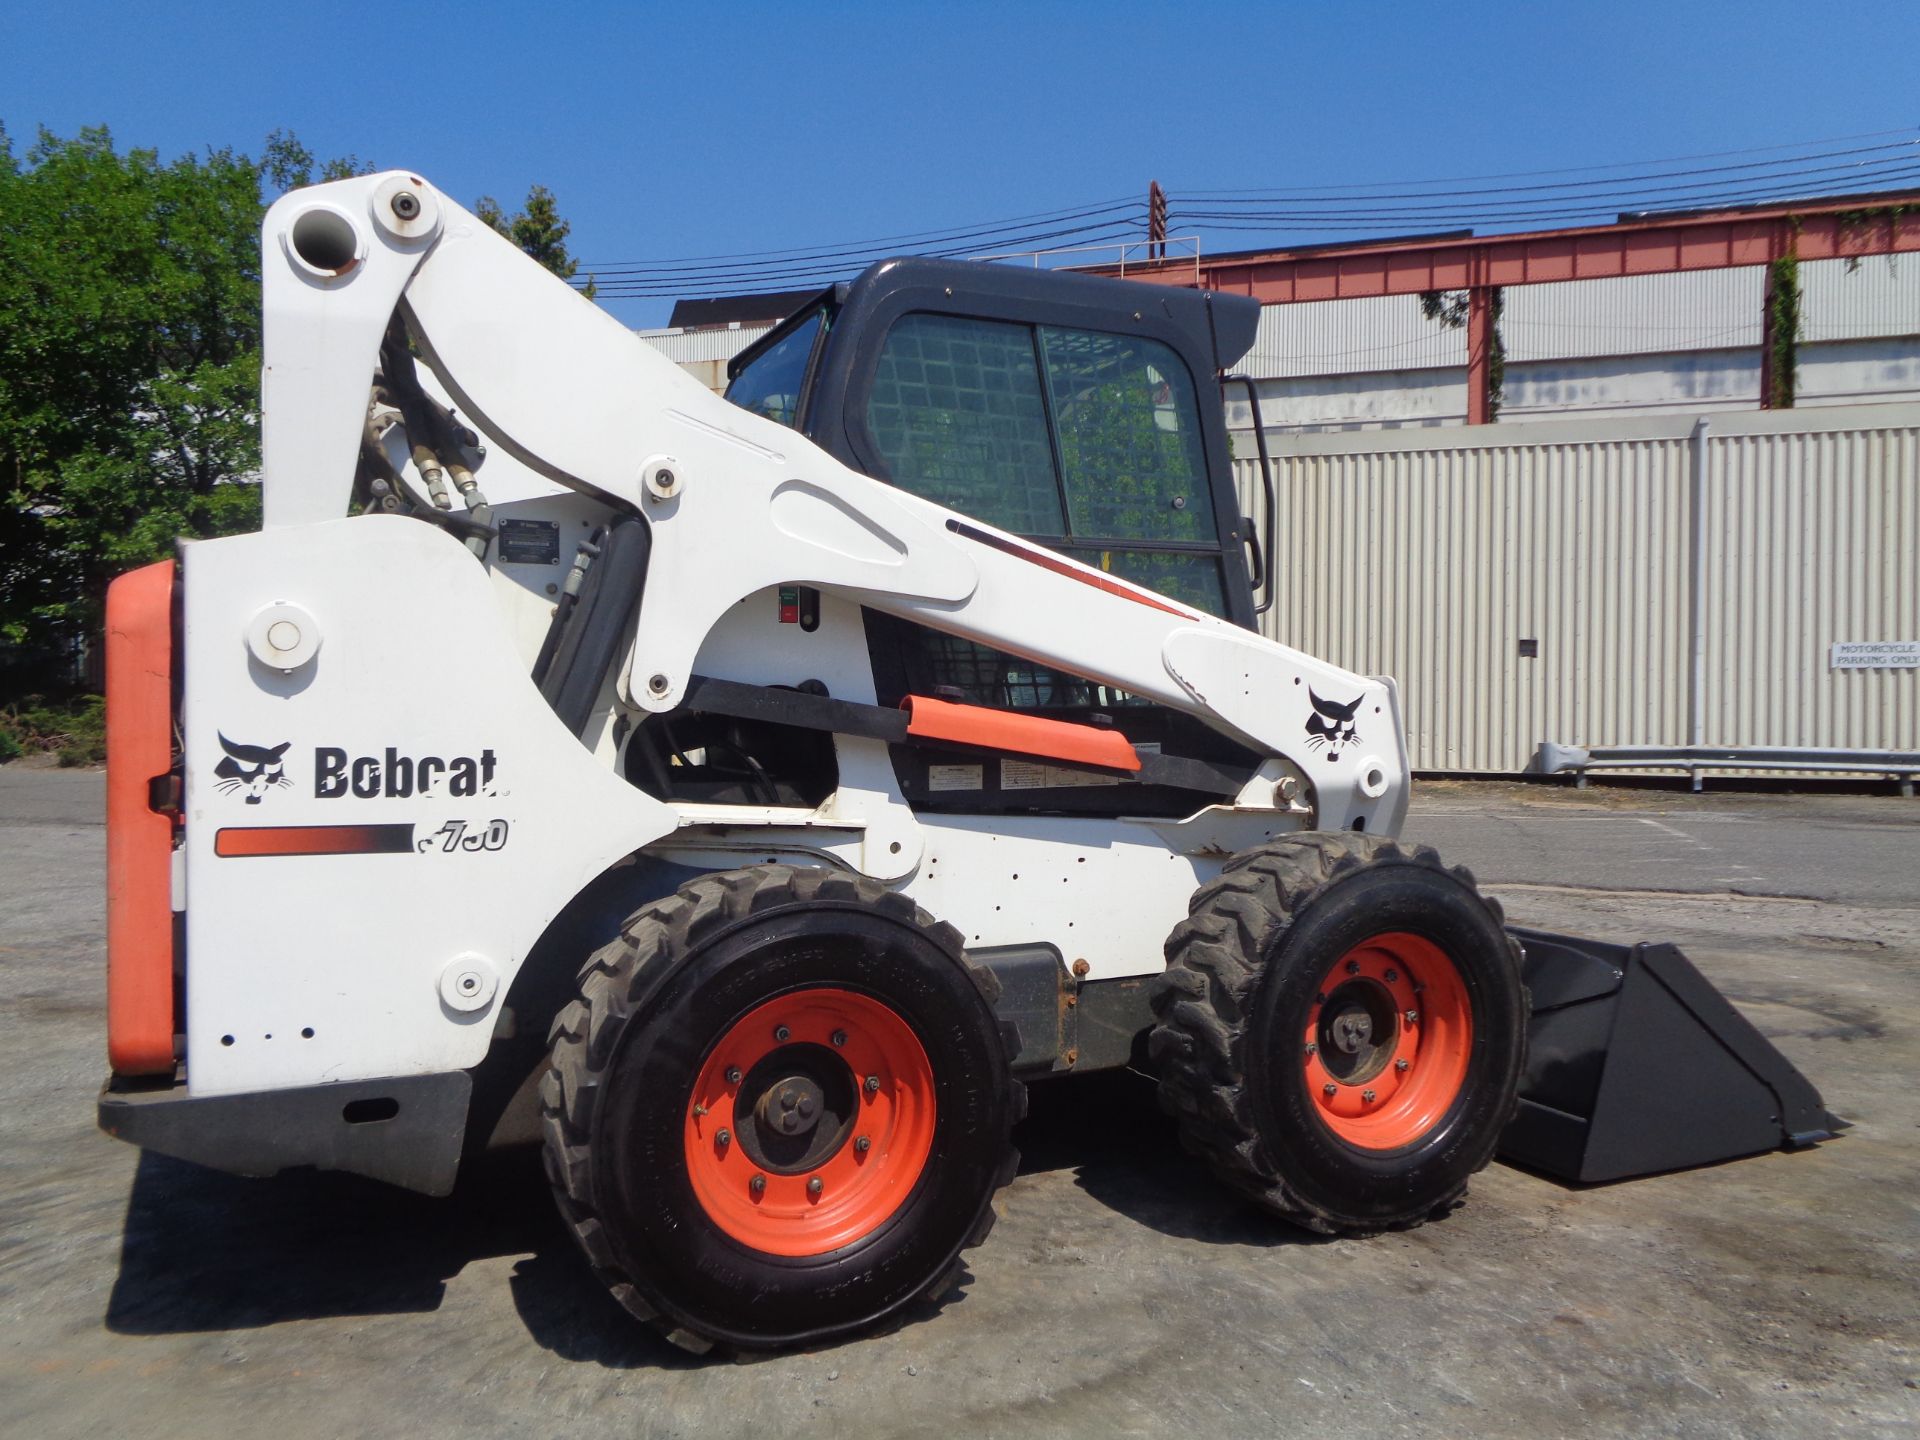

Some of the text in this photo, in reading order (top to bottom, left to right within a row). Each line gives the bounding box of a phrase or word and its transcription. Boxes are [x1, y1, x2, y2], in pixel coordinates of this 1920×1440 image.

[1841, 645, 1916, 653] MOTORCYCLE
[1838, 656, 1886, 664] PARKING
[315, 747, 497, 799] Bobcat
